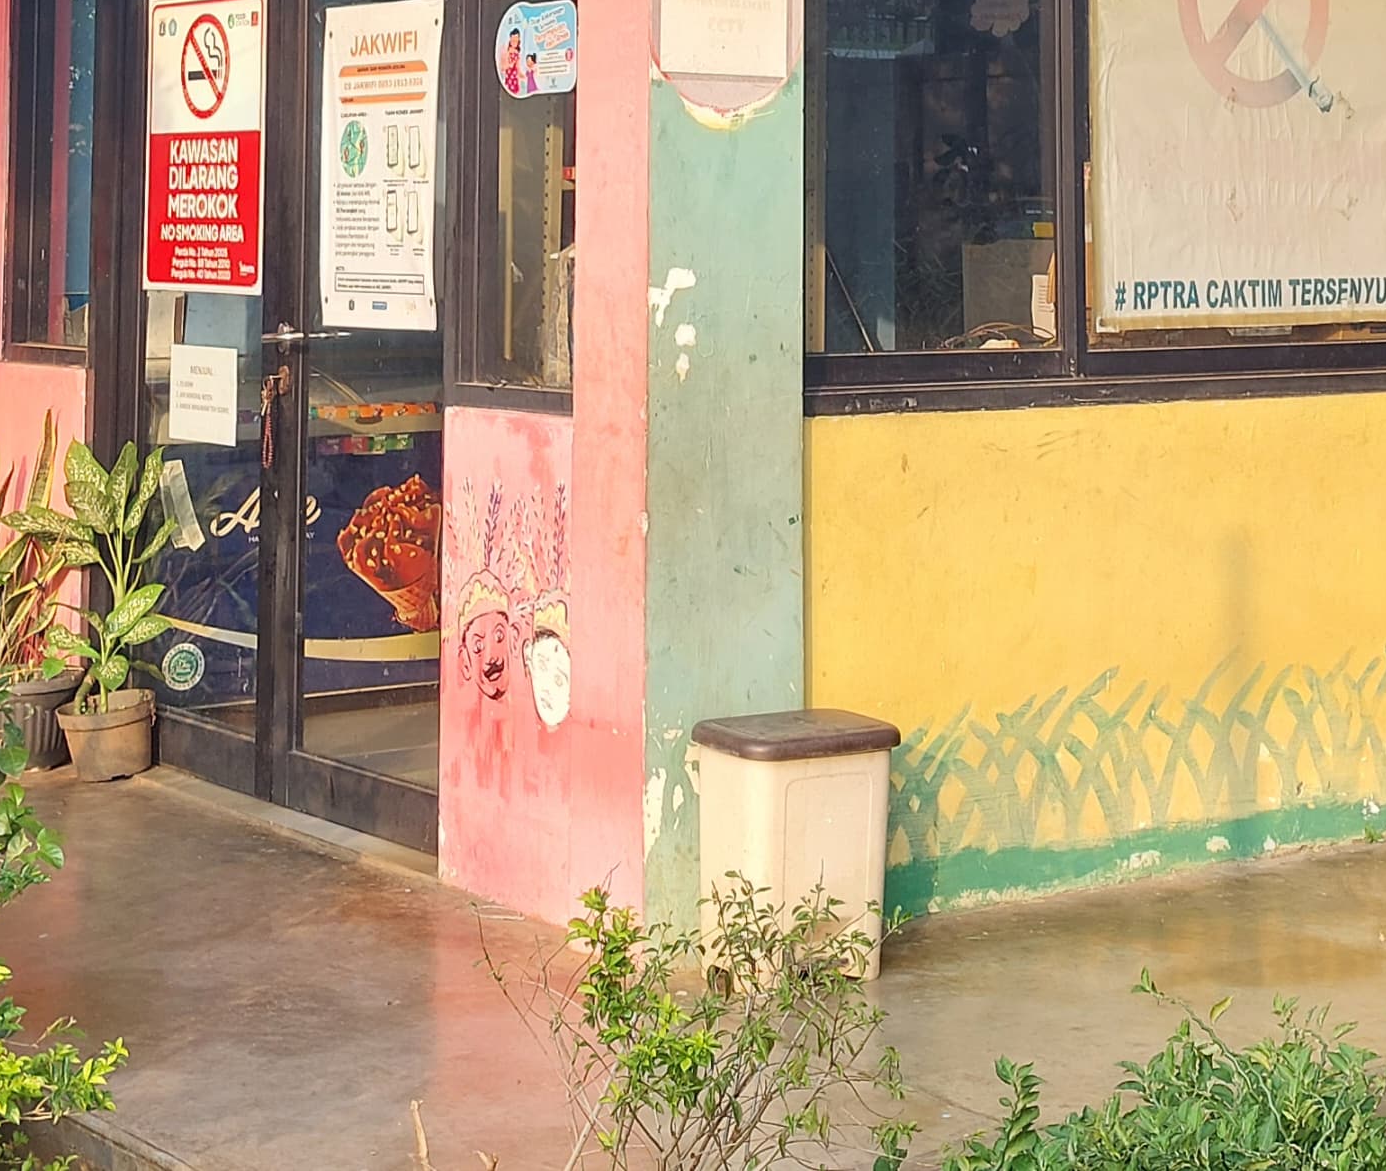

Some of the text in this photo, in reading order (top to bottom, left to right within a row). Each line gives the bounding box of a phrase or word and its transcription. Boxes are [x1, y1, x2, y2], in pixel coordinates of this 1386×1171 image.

[350, 29, 419, 58] JAKWIFI
[169, 136, 239, 164] KAWASAN
[168, 163, 239, 191] DILARANG
[167, 192, 239, 219] MEROKOK
[160, 223, 244, 242] NO SMOKING AREA
[1115, 281, 1127, 310] #
[1132, 279, 1201, 309] RPTRA
[1206, 278, 1283, 309] CAKTIM
